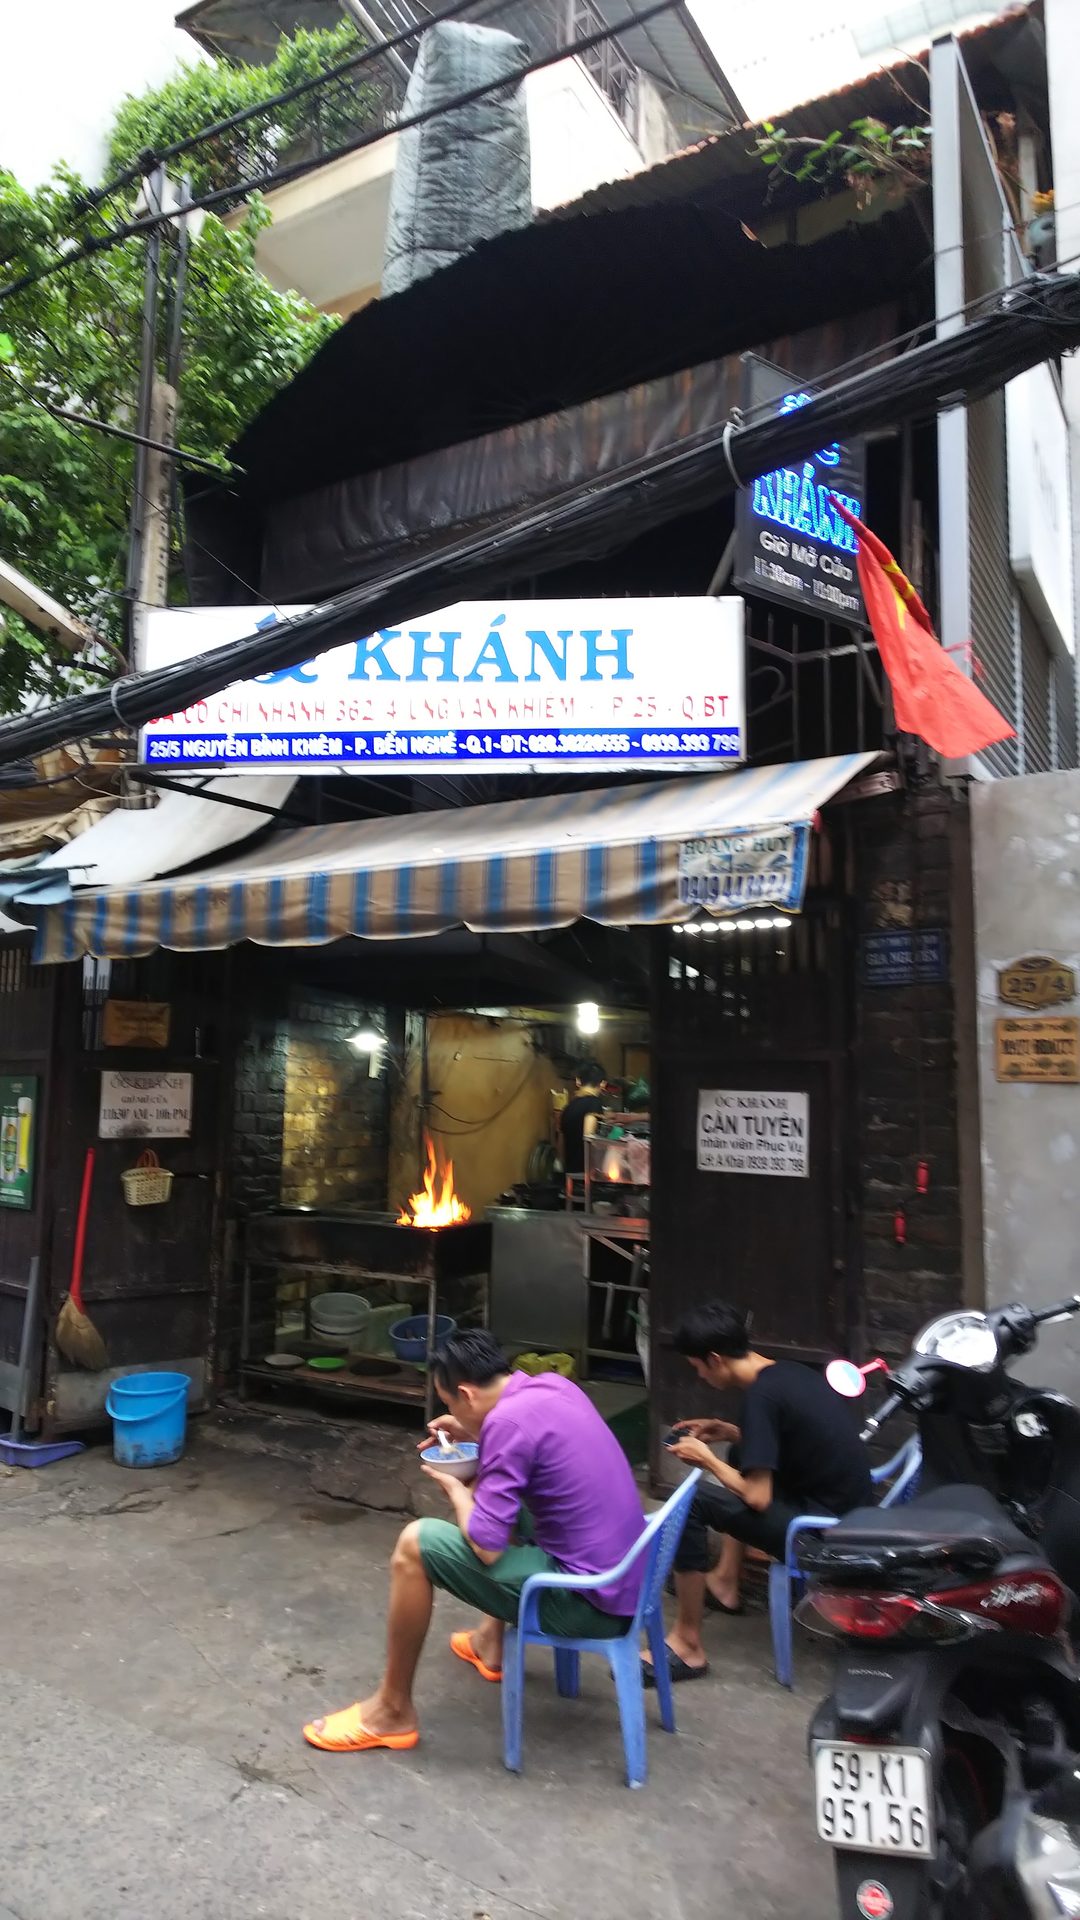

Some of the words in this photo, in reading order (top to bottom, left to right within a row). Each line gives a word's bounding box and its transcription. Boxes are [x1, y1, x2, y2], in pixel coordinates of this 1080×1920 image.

[348, 612, 635, 683] KHÁNH
[832, 1752, 906, 1798] 59-K1
[822, 1797, 924, 1849] 951.56
